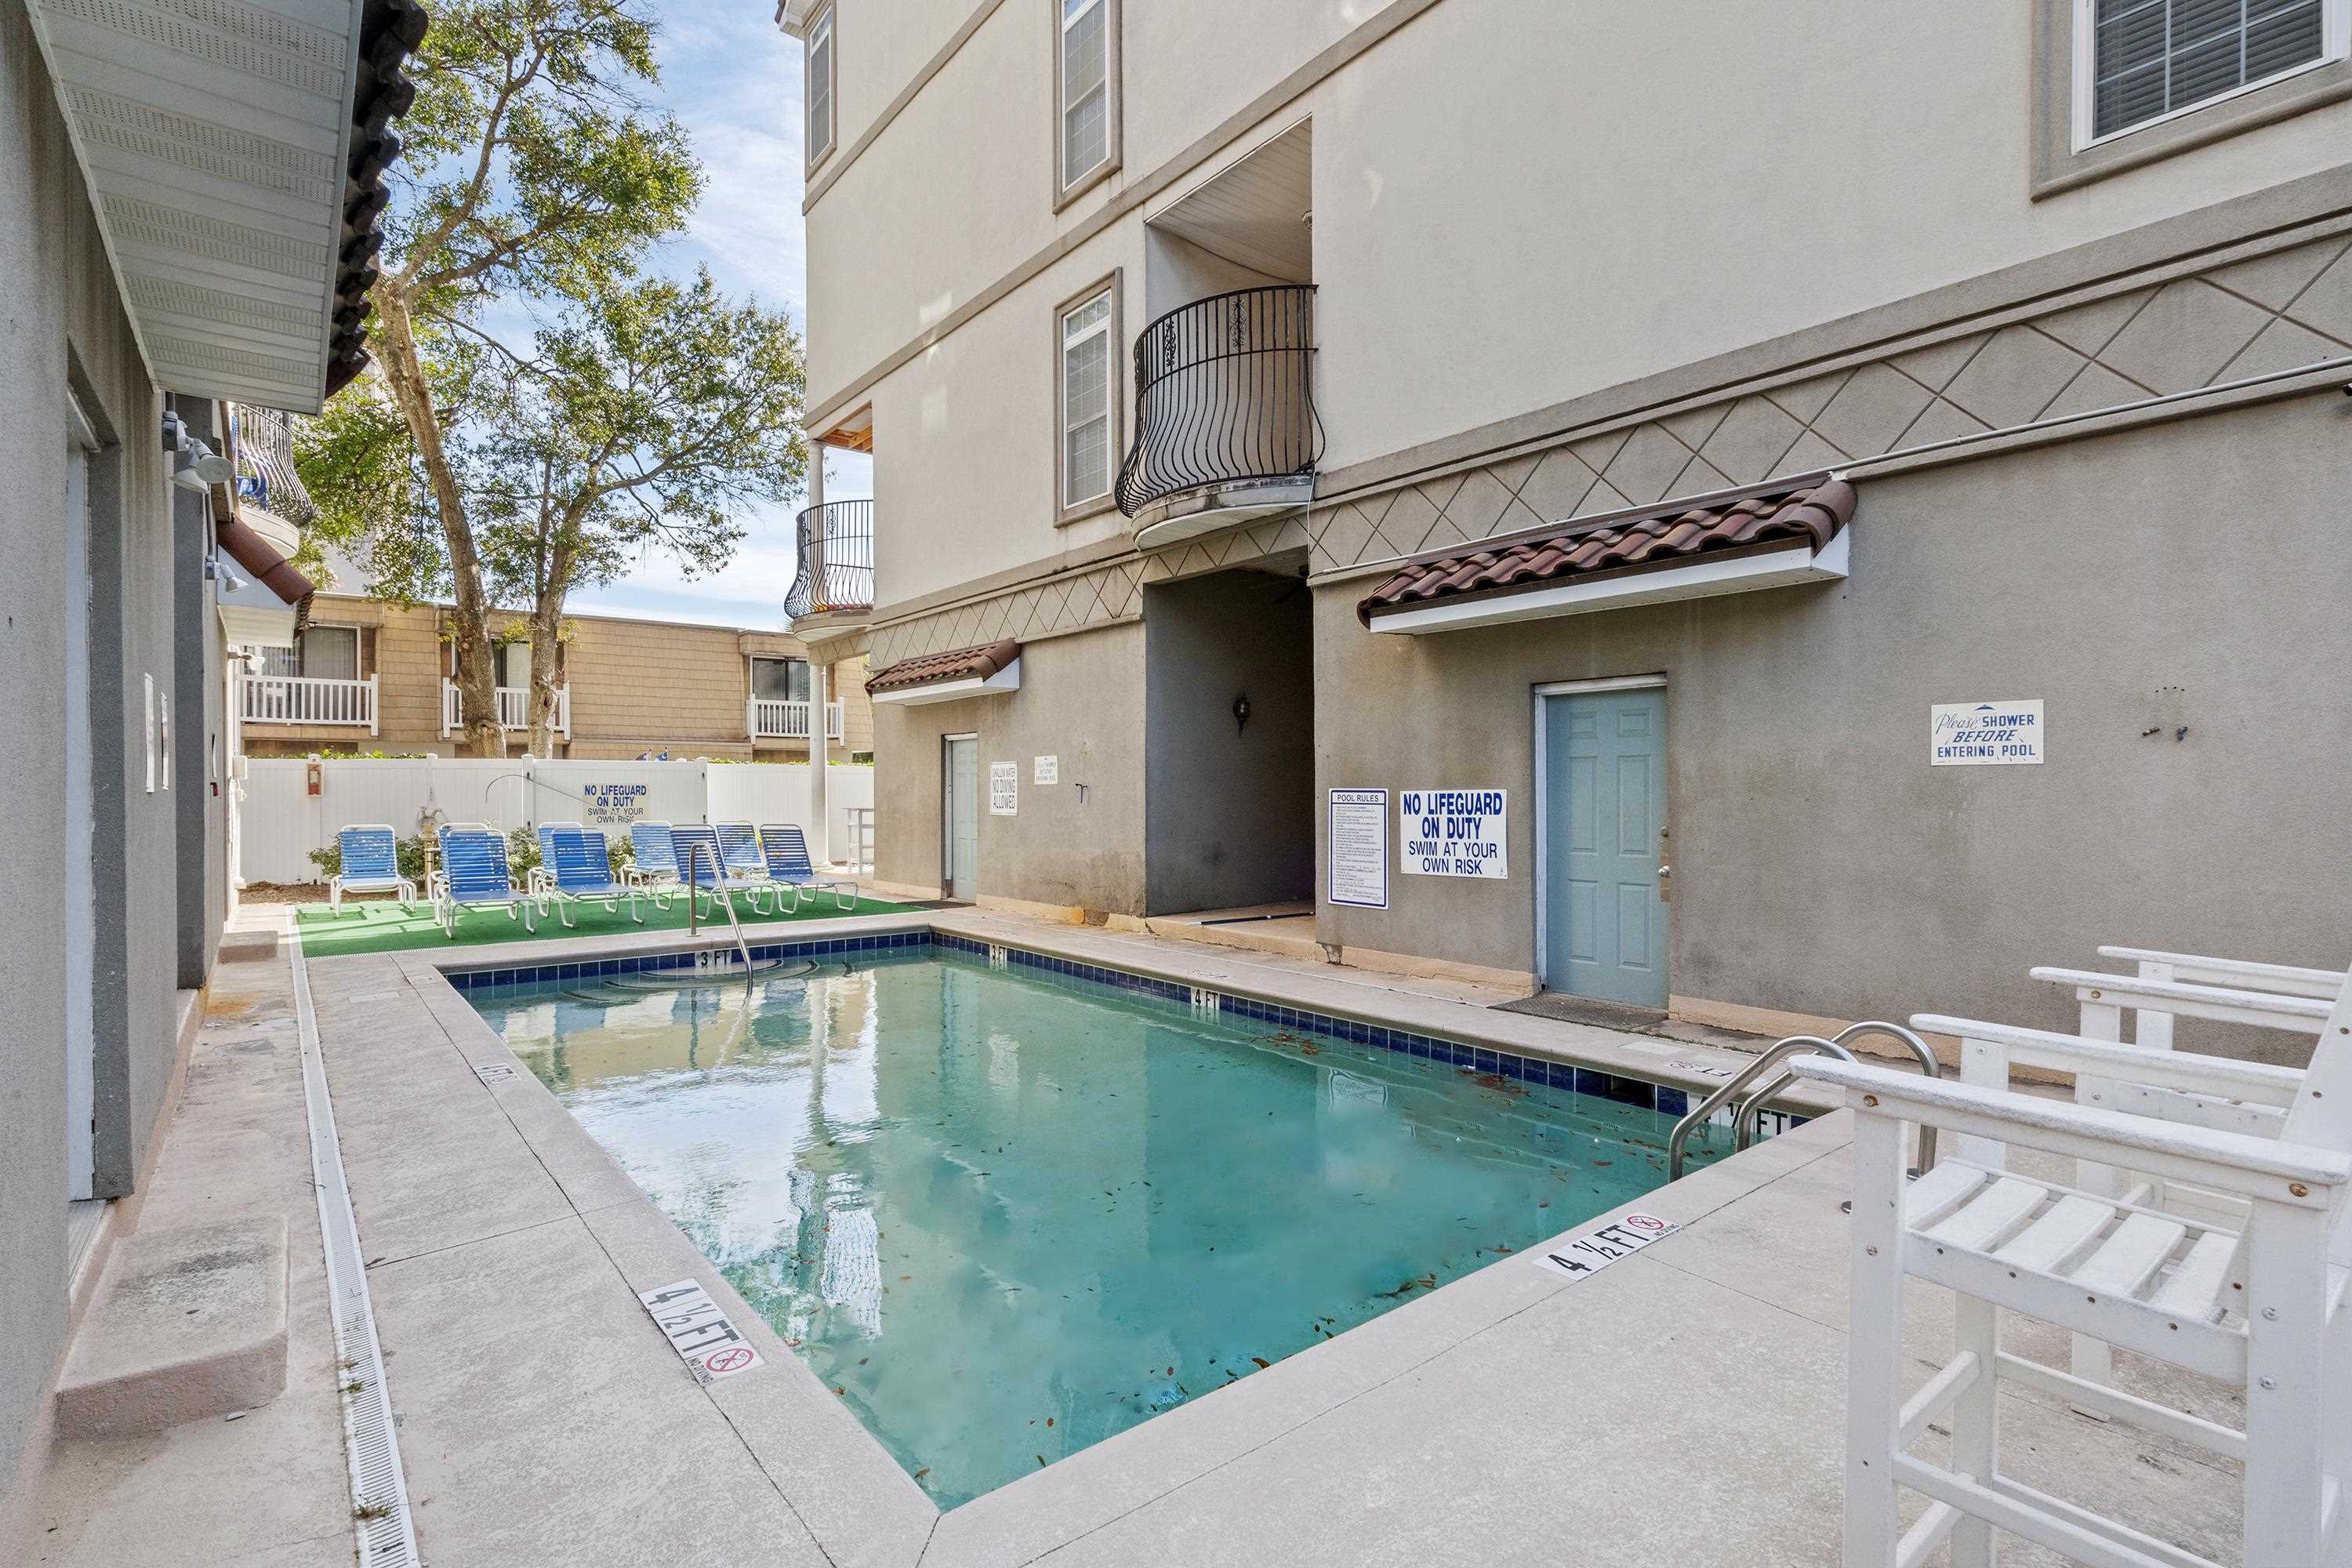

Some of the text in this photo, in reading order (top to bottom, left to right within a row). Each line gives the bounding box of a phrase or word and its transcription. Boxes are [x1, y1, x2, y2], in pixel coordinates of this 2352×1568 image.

[1936, 711, 2035, 734] Please SHOWER
[1953, 729, 2018, 742] BEFORE
[1937, 745, 2036, 757] ENTERING POOL
[585, 785, 647, 795] NO LIFEGUARD
[597, 797, 635, 807] ON DUTY
[993, 795, 1015, 809] ALLOWED
[1403, 793, 1503, 815] NO LIFEGUARD
[1422, 818, 1482, 840] ON DUTY
[1409, 841, 1497, 858] SWIM AT YOUR
[1422, 858, 1450, 873] OWN
[1456, 859, 1483, 874] RISK
[701, 949, 730, 966] 3 FT
[1195, 989, 1218, 1011] 4 FT
[1756, 1108, 1788, 1135] FT
[1548, 1254, 1592, 1272] 4
[1594, 1224, 1650, 1249] FT
[648, 1287, 700, 1305] 4
[672, 1319, 740, 1352] FT
[688, 1357, 701, 1370] NO
